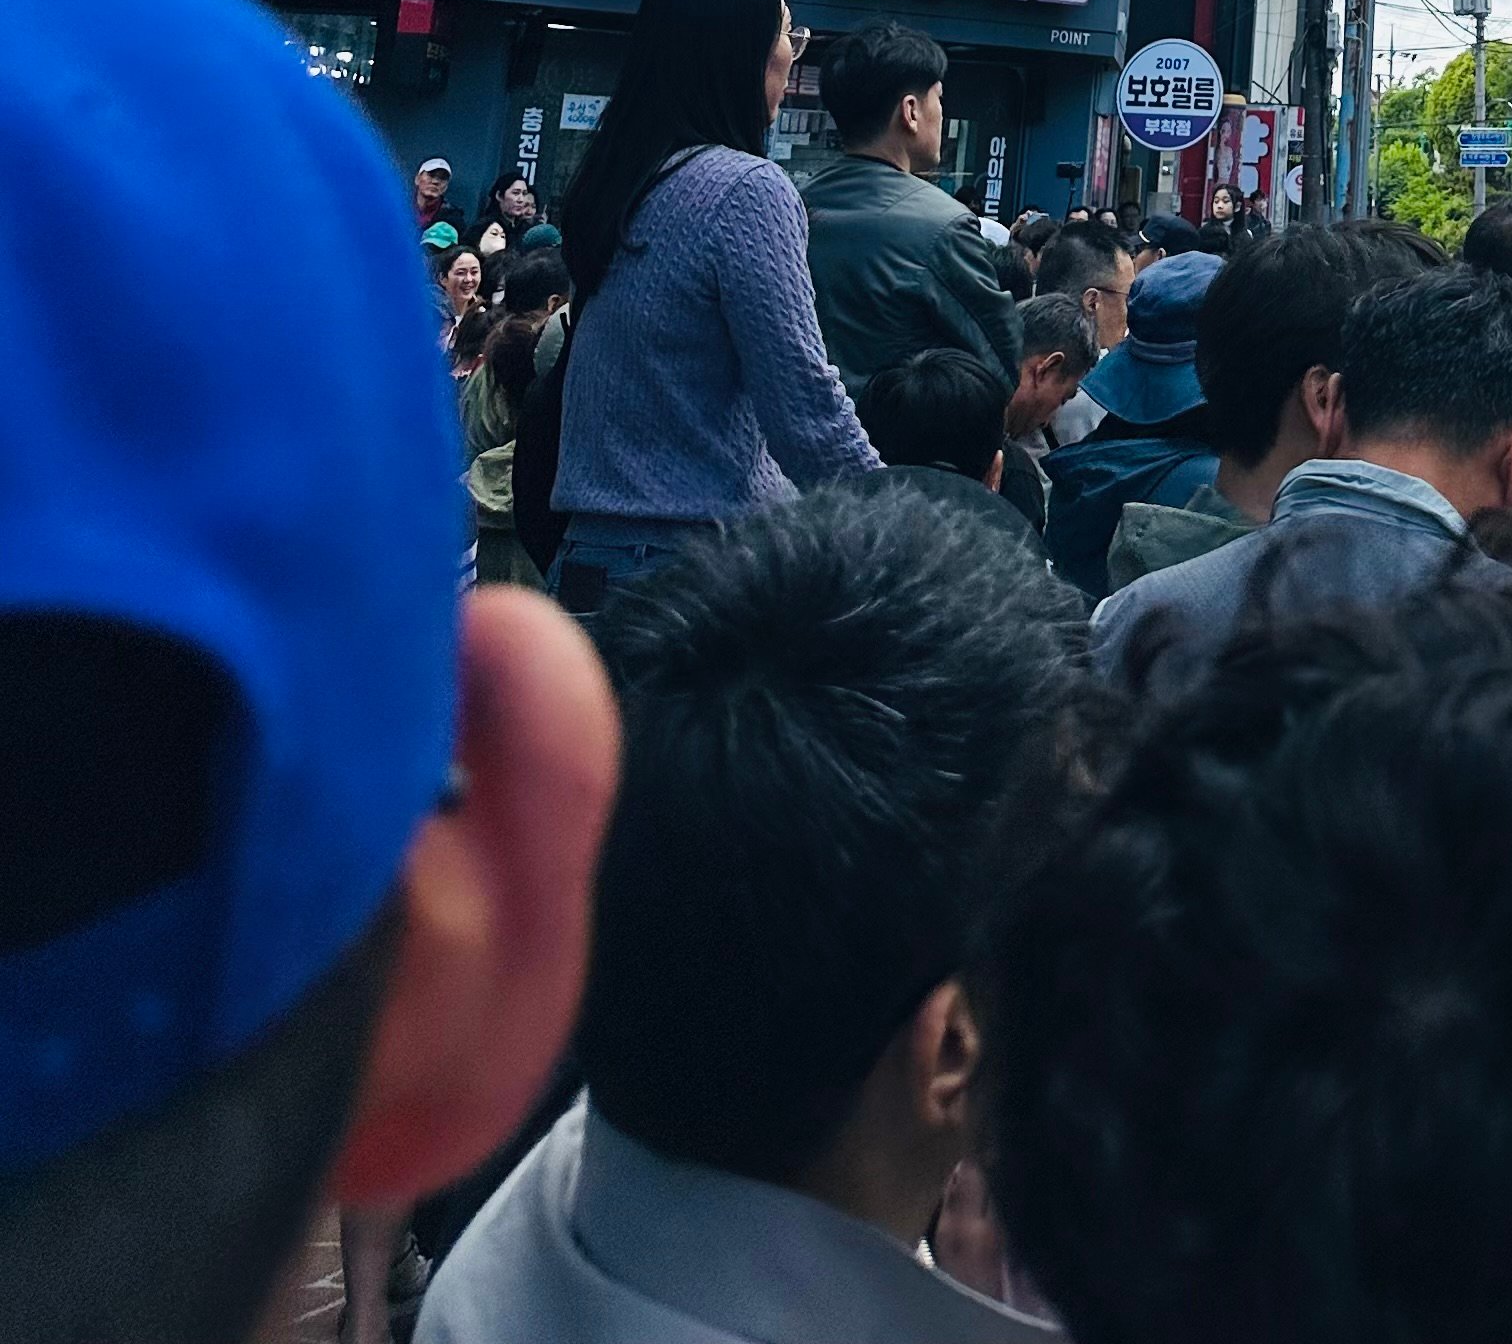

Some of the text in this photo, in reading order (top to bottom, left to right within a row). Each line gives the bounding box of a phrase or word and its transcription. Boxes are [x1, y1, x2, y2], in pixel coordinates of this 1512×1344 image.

[1050, 29, 1092, 46] POINT
[1155, 57, 1190, 71] 2007
[1125, 74, 1215, 111] 보호필름
[1144, 118, 1192, 137] 부착점
[516, 106, 544, 187] 충전기
